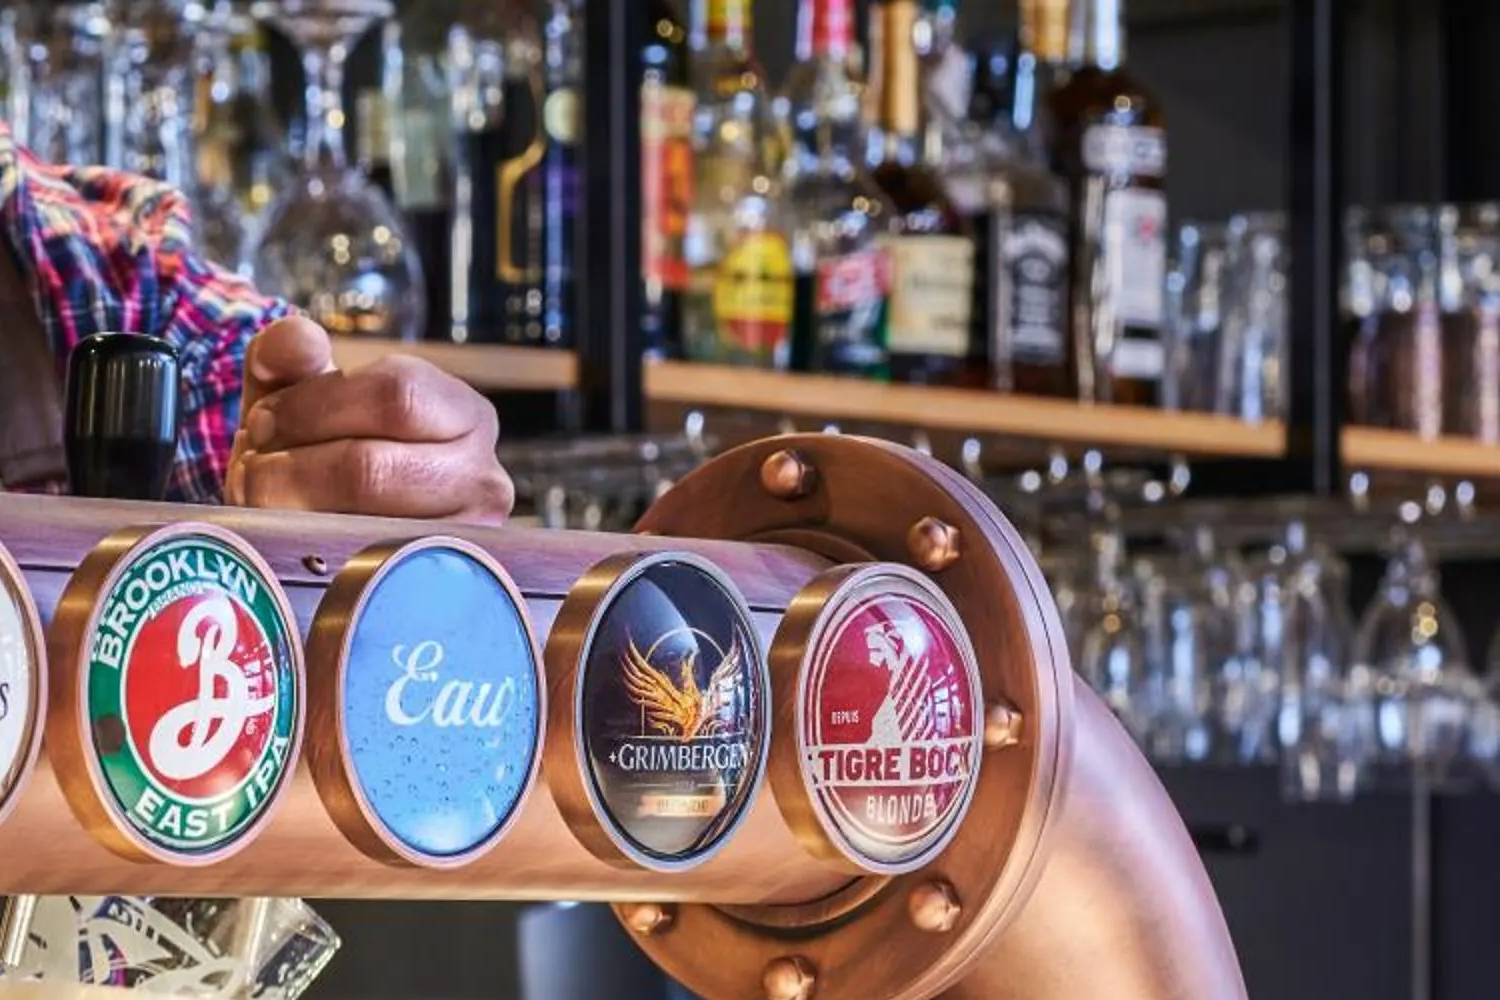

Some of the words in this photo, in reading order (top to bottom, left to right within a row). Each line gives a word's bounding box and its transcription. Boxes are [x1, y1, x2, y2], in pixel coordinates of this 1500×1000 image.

[99, 549, 258, 670] BROOKLYN
[386, 640, 516, 727] Eau
[134, 786, 235, 837] EAST
[245, 735, 290, 809] IPA
[618, 743, 748, 771] GRIMBERGEN
[818, 748, 901, 781] TIGRE
[909, 741, 973, 780] BOCK
